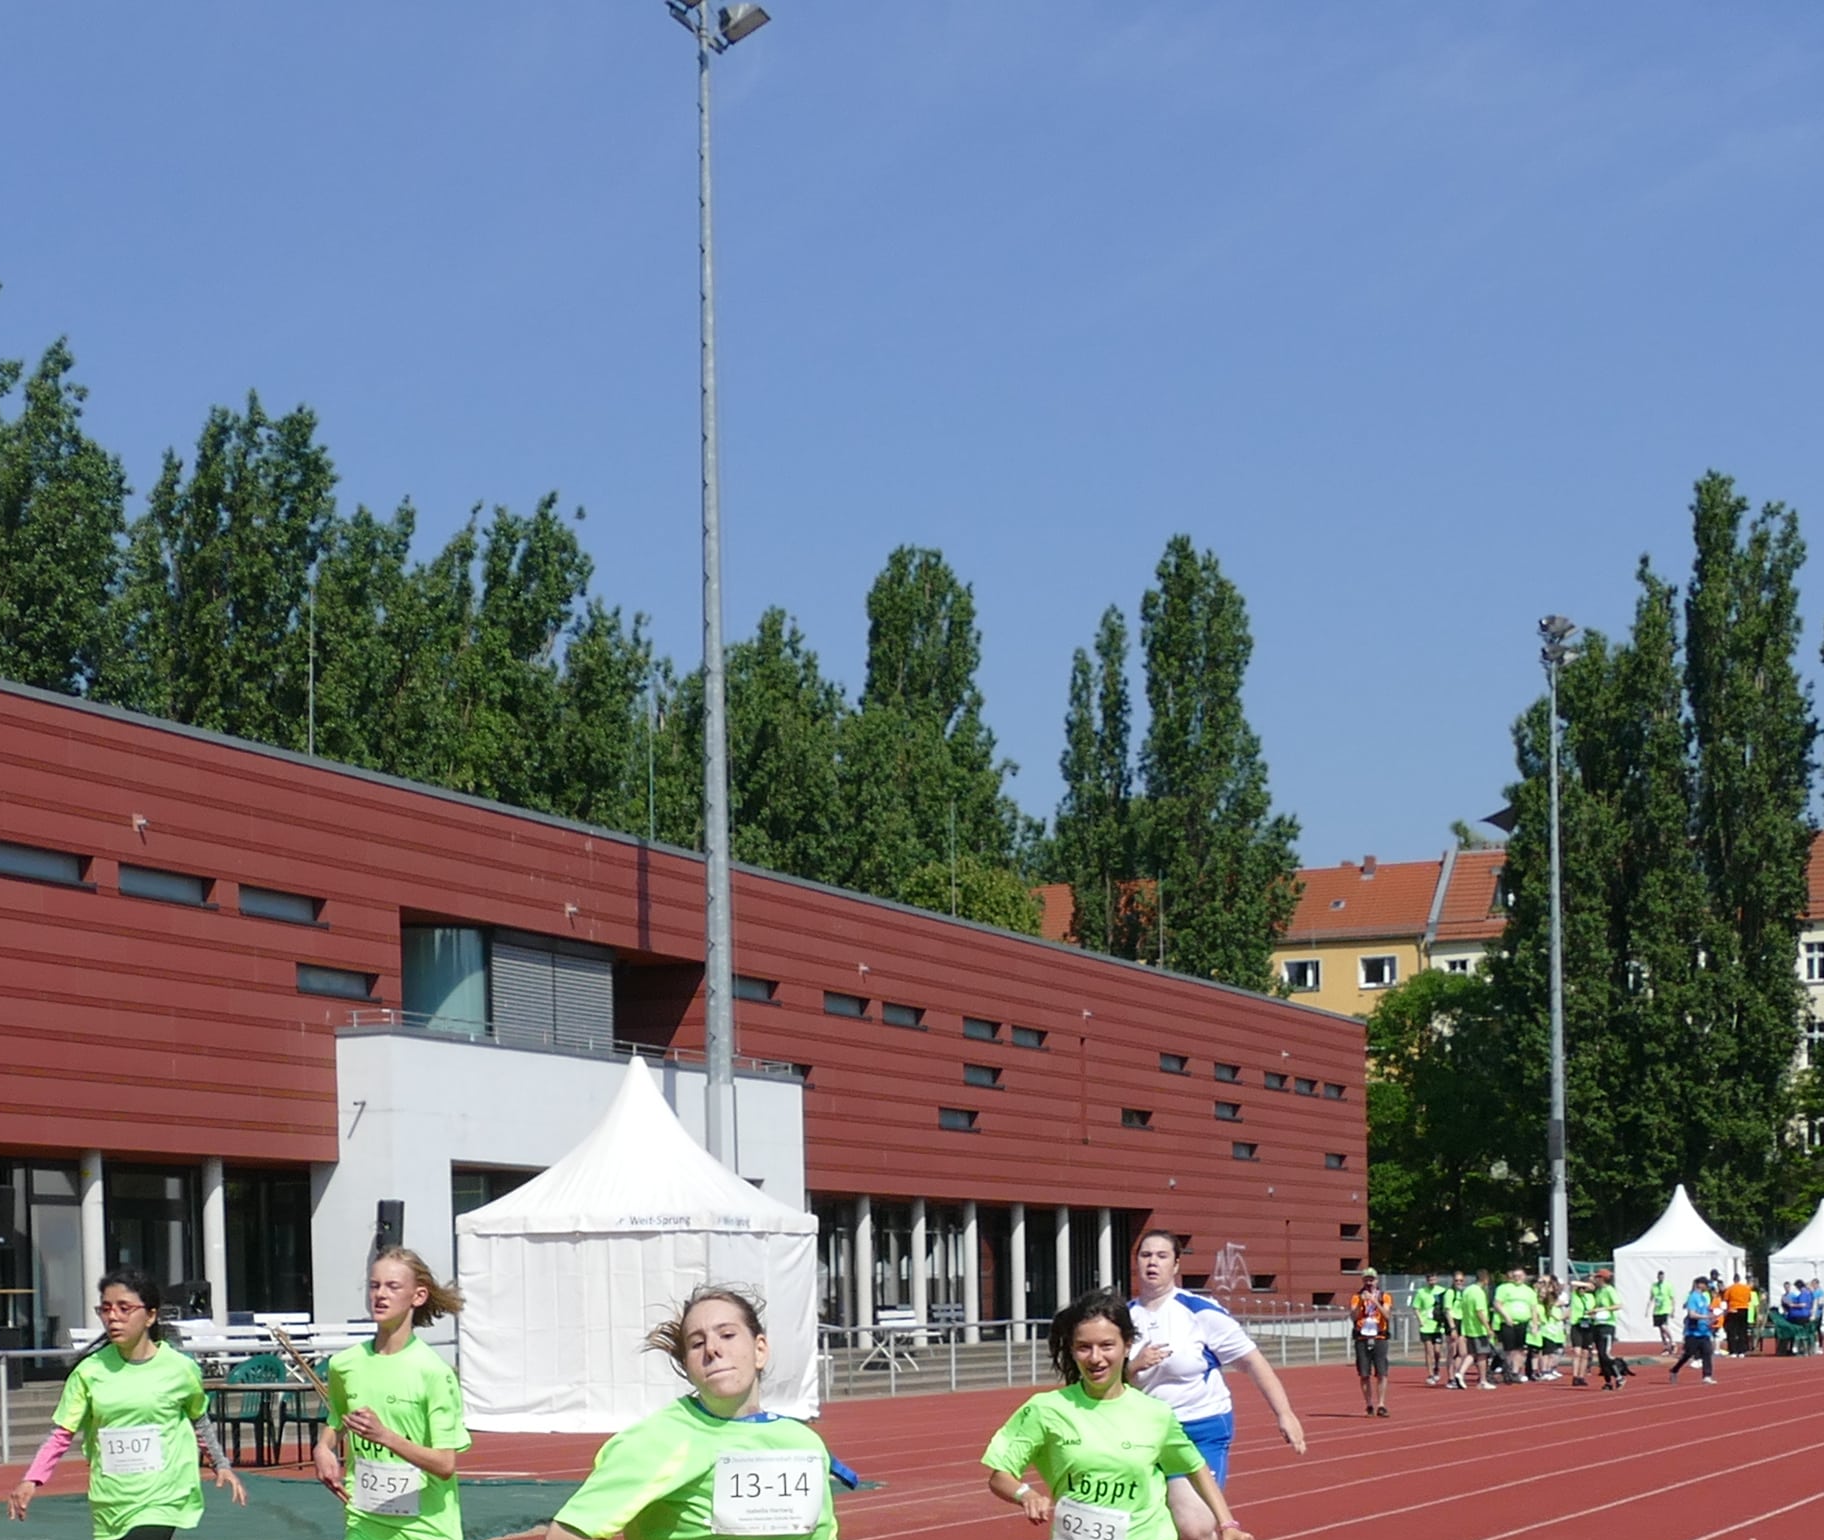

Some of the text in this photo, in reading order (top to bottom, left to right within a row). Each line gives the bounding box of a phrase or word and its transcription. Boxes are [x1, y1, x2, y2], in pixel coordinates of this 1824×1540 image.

[107, 1438, 152, 1455] 13-07
[361, 1472, 409, 1494] 62-57
[730, 1472, 811, 1498] 13-14
[1062, 1514, 1116, 1540] 62-33
